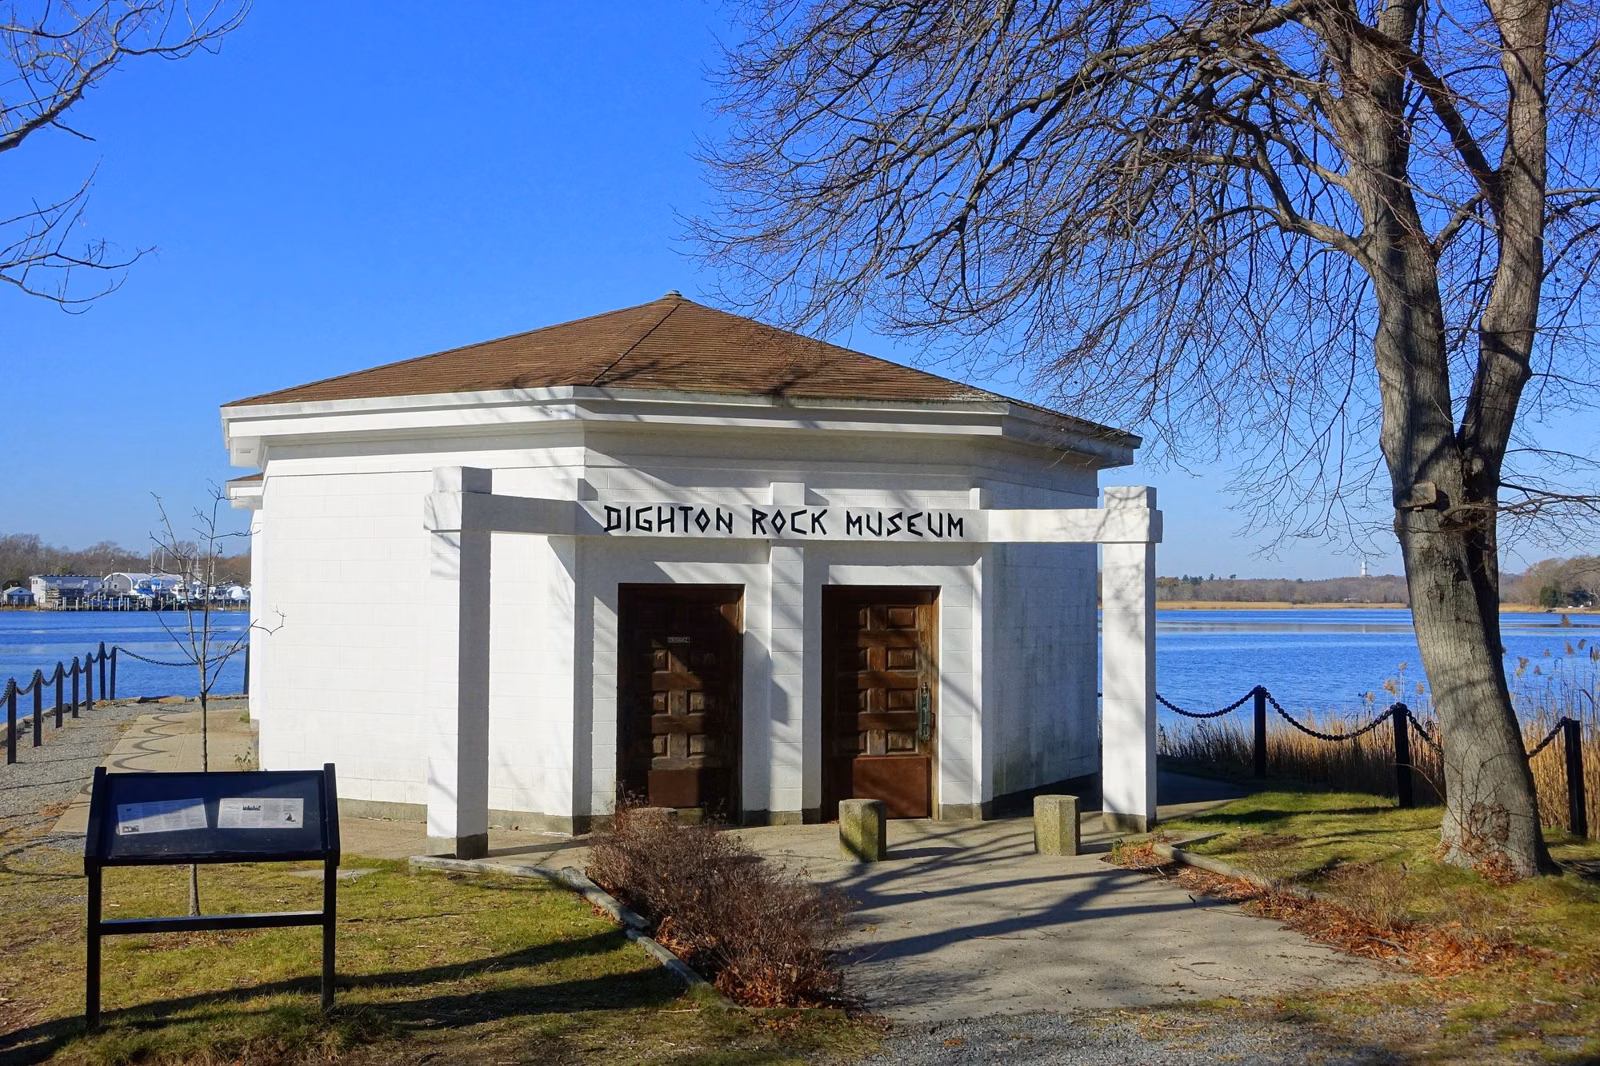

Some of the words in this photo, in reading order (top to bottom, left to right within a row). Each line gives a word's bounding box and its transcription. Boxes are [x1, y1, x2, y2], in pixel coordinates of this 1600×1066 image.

[603, 505, 733, 534] DIGHTON
[751, 508, 828, 536] ROCK
[846, 511, 964, 538] MUSEUM
